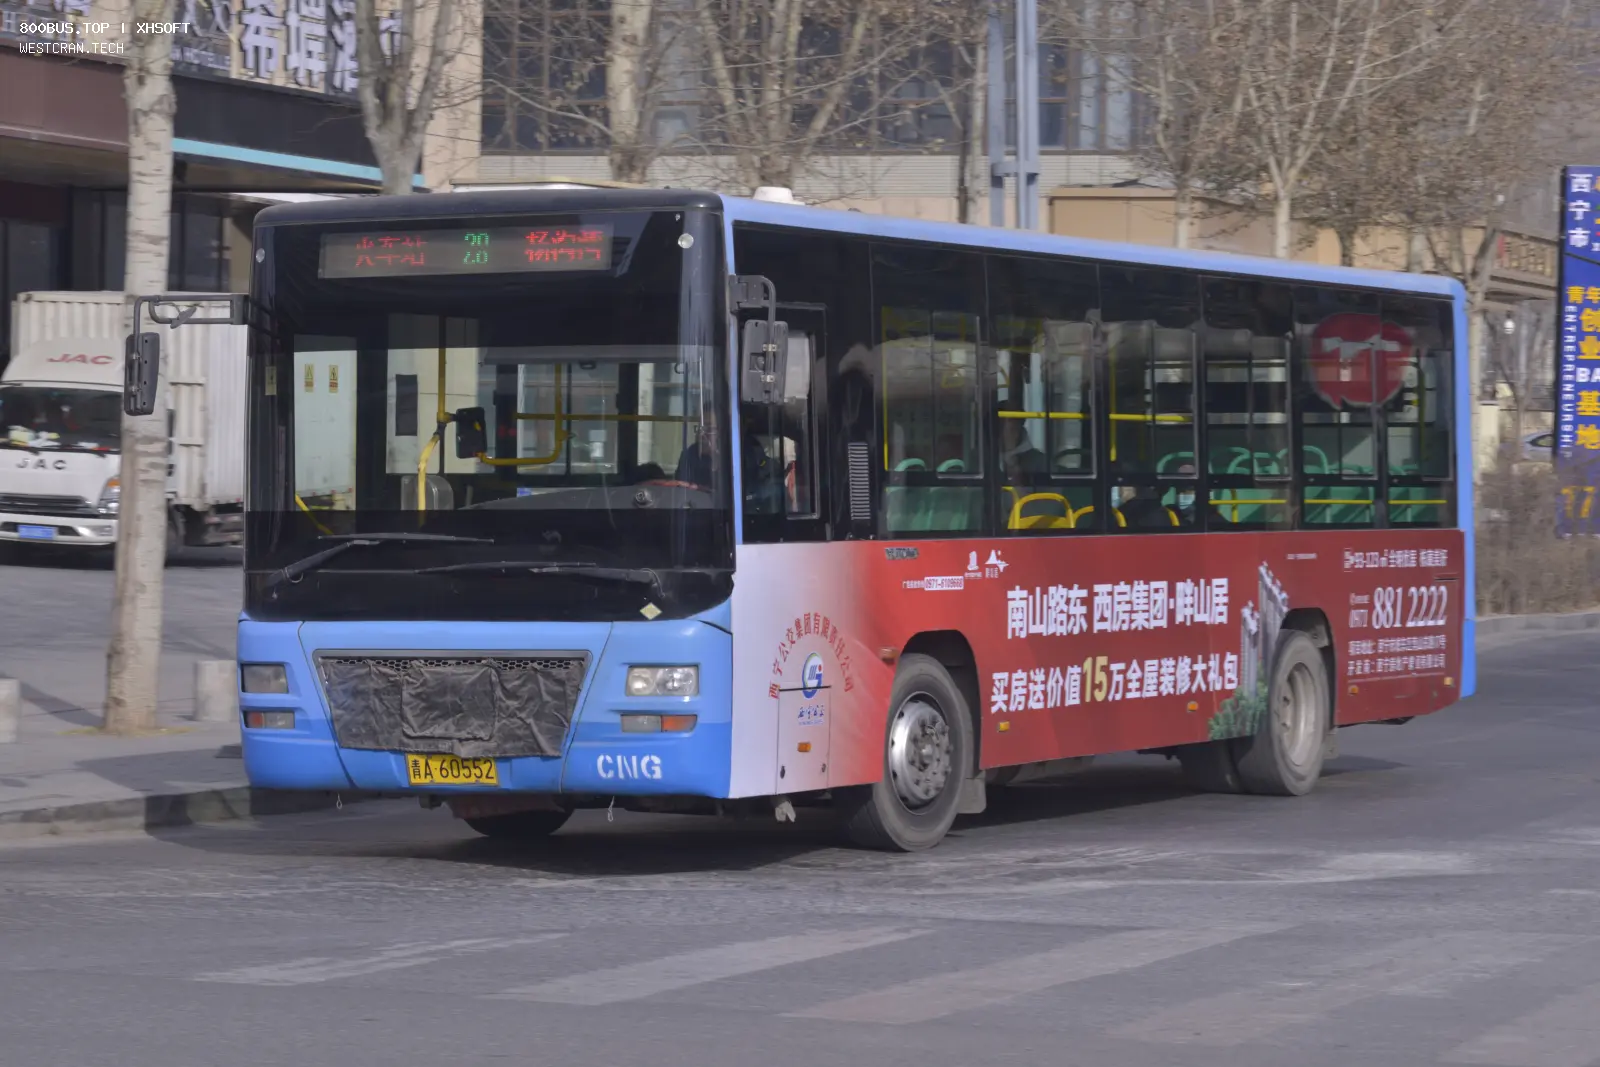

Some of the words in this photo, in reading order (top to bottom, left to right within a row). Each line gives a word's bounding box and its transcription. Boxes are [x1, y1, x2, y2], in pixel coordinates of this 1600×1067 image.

[1568, 174, 1594, 248] 西宁市
[462, 231, 490, 265] 20
[46, 352, 115, 366] JAC
[16, 458, 68, 471] JAC
[1007, 585, 1088, 639] 南山路东
[1372, 586, 1404, 629] 881
[1405, 585, 1448, 628] 2222
[990, 651, 1239, 714] 买房送价值15万全屋装修大礼包
[596, 754, 663, 779] CNG
